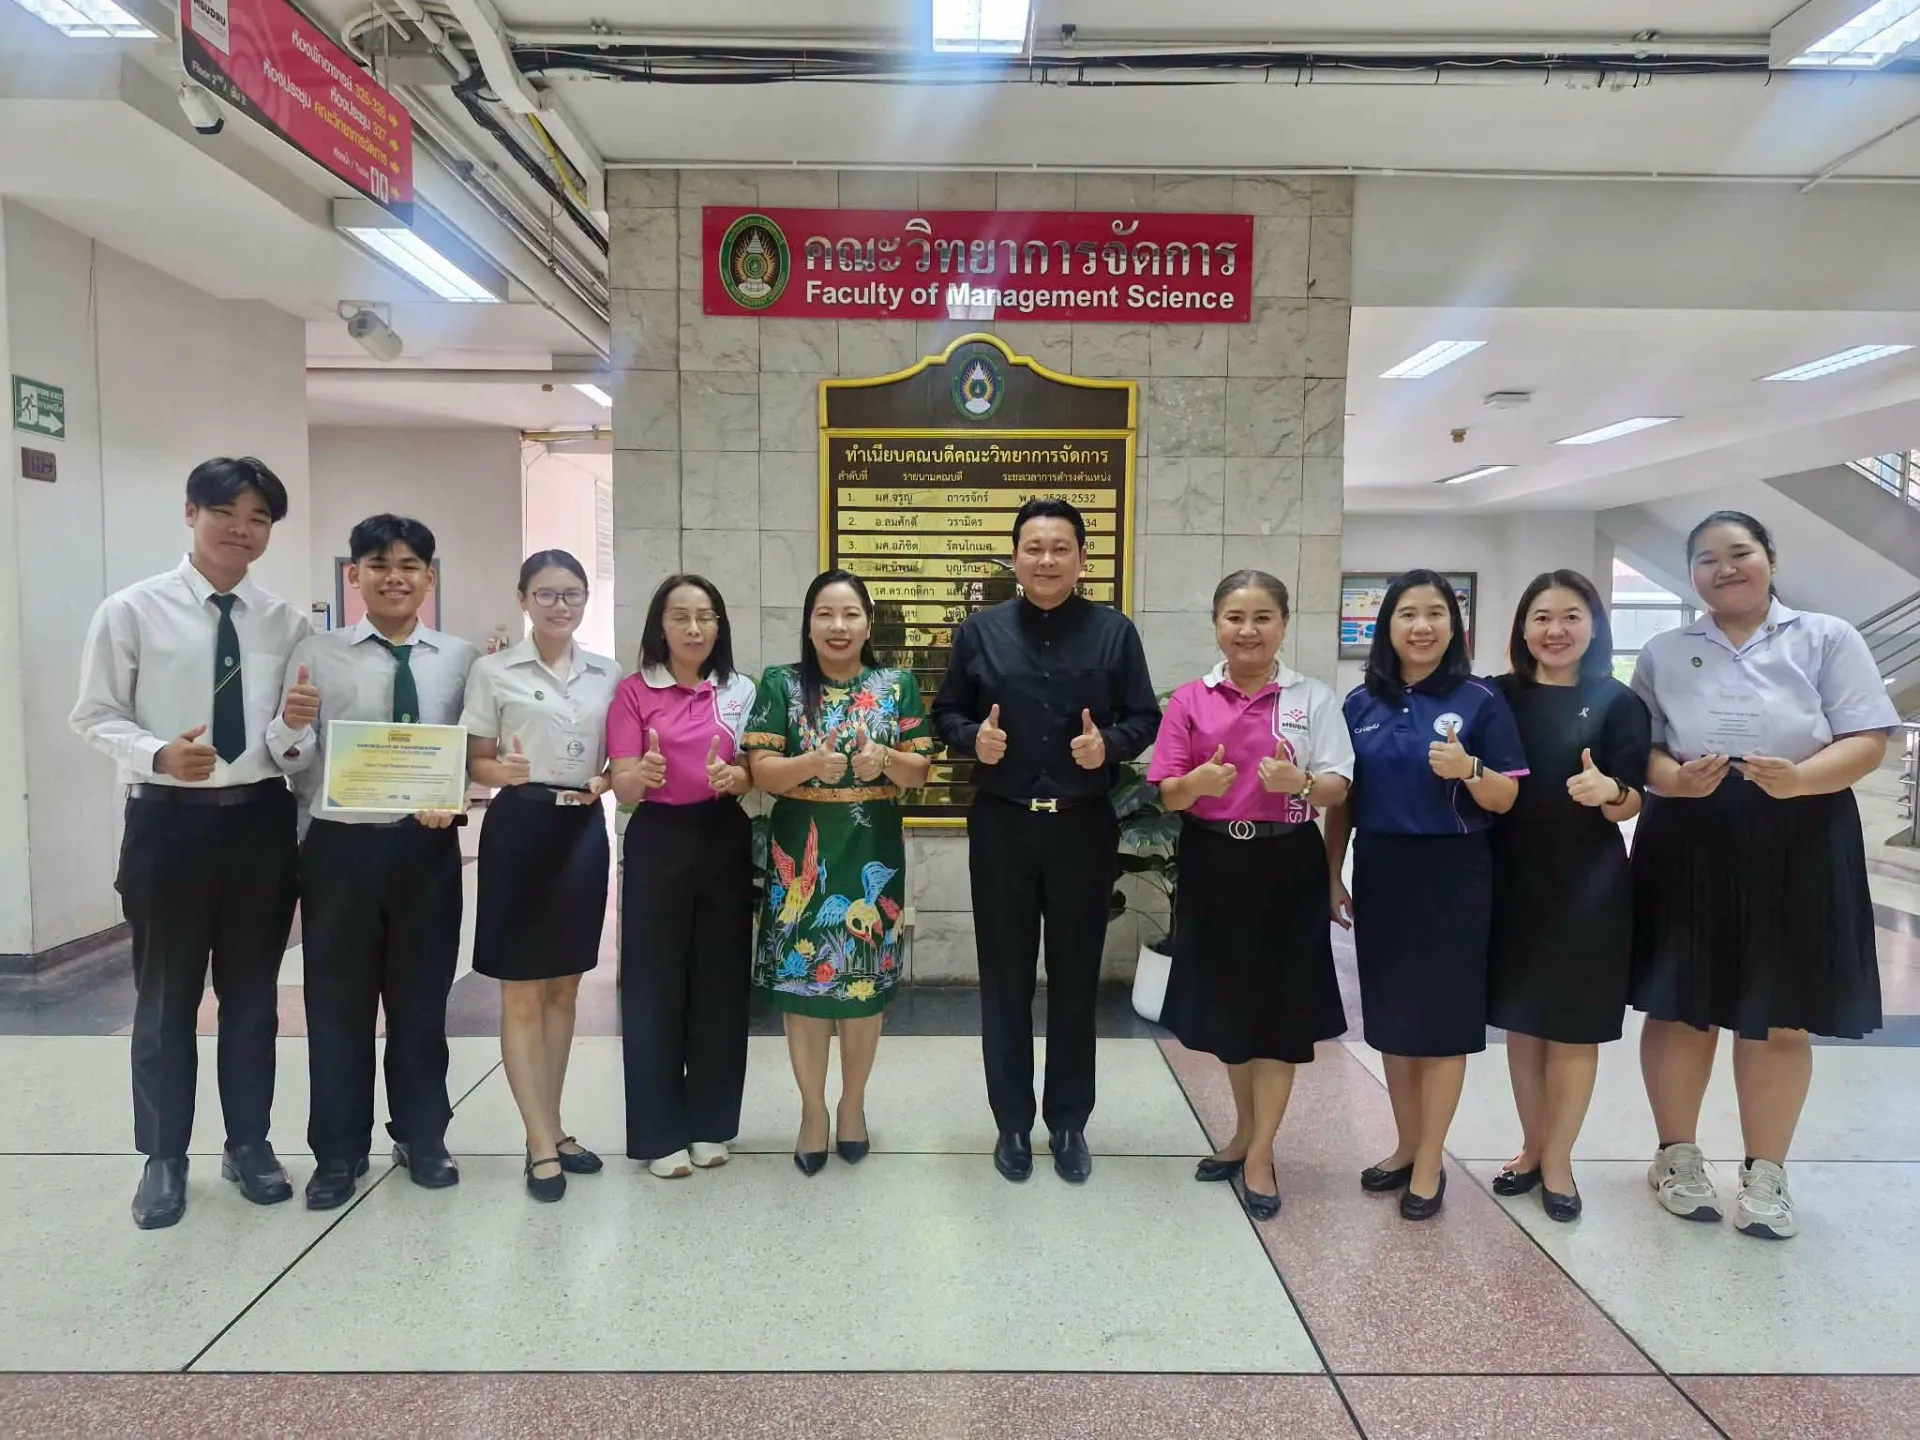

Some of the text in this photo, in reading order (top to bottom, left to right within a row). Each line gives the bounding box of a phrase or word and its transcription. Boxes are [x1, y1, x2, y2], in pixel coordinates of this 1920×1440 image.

[263, 57, 312, 109] ห้องประชุม
[804, 217, 1237, 276] คณะวิทยาการจัดการ
[806, 280, 904, 310] Faculty
[910, 282, 939, 306] of
[947, 282, 1119, 313] Management
[1127, 284, 1235, 309] Science
[845, 444, 1109, 463] ทำเนียบคณบดีคณะวิทยาการจัดการ
[838, 468, 868, 481] ลำดับที่
[847, 492, 856, 502] 1.
[848, 516, 858, 526] 2.
[848, 540, 857, 551] 3.
[847, 562, 857, 572] 4.
